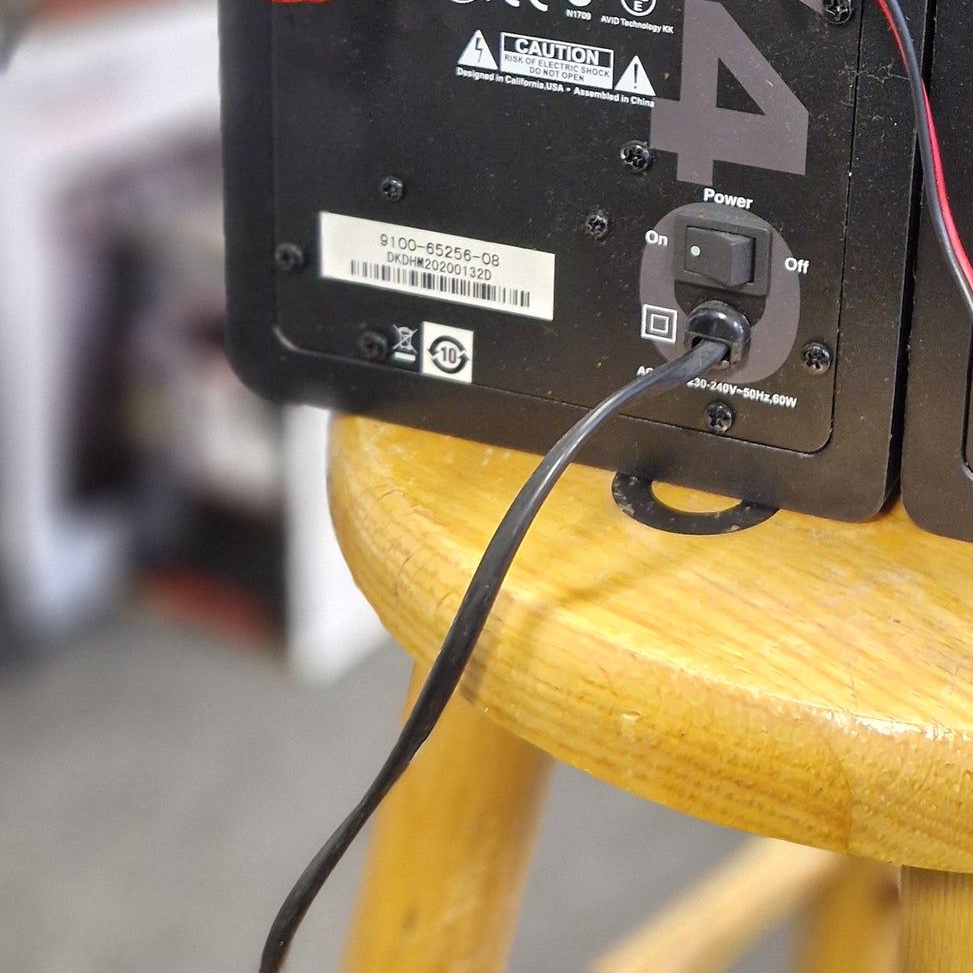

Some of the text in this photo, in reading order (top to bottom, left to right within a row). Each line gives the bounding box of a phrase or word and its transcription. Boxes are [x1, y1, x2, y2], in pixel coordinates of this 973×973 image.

[565, 9, 592, 21] N1709
[633, 0, 643, 12] E
[601, 15, 674, 34] AVID Technology KK
[515, 38, 600, 66] CAUTION
[504, 54, 611, 79] RISK OF ELECTRIC SHOCK
[529, 66, 585, 83] DO NOT OPEN
[455, 66, 495, 84] Designed
[495, 73, 504, 83] in
[574, 86, 621, 104] Assembled
[622, 94, 630, 104] in
[631, 96, 655, 109] China
[703, 187, 754, 210] Power
[645, 229, 668, 247] On
[379, 232, 501, 268] 9100-65256-08
[784, 256, 810, 275] Off
[440, 345, 457, 365] 10
